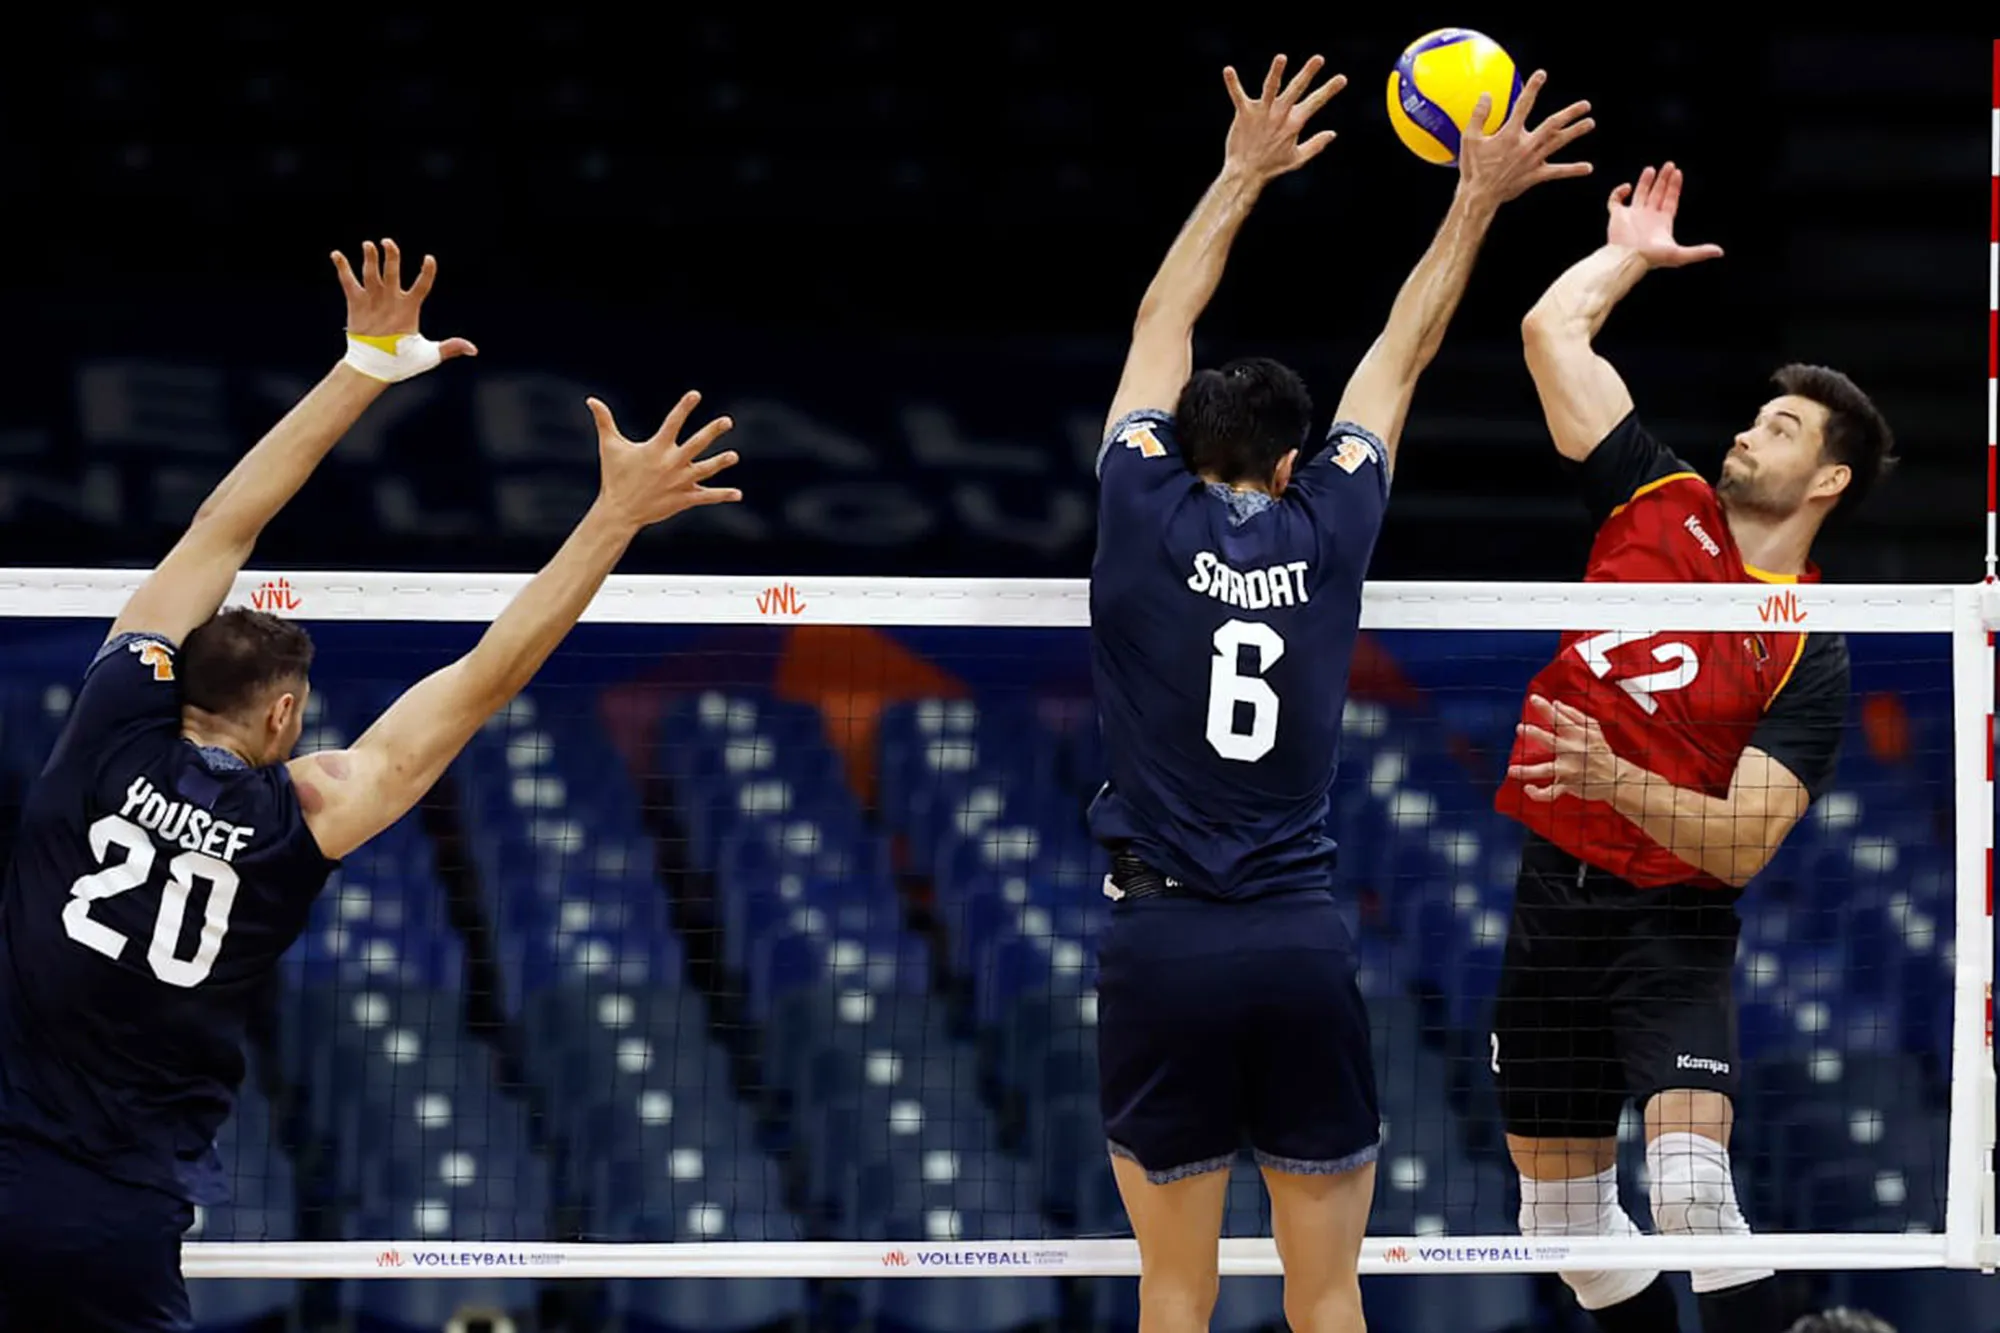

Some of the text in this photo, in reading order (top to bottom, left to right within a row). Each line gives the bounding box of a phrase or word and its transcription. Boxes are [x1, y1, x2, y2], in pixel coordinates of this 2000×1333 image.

[1684, 514, 1720, 557] Kempa
[251, 576, 302, 610] VNL
[756, 582, 806, 615] VNL
[1758, 589, 1808, 624] VNL
[1206, 618, 1284, 762] 6
[120, 776, 255, 862] YOUSEF
[61, 813, 241, 988] 20
[1677, 1054, 1730, 1074] Kempa
[376, 1248, 528, 1267] VNL VOLLEYBALL
[882, 1249, 1031, 1266] VNL VOLLEYBALL
[1383, 1245, 1533, 1263] VNL VOLLEYBALL
